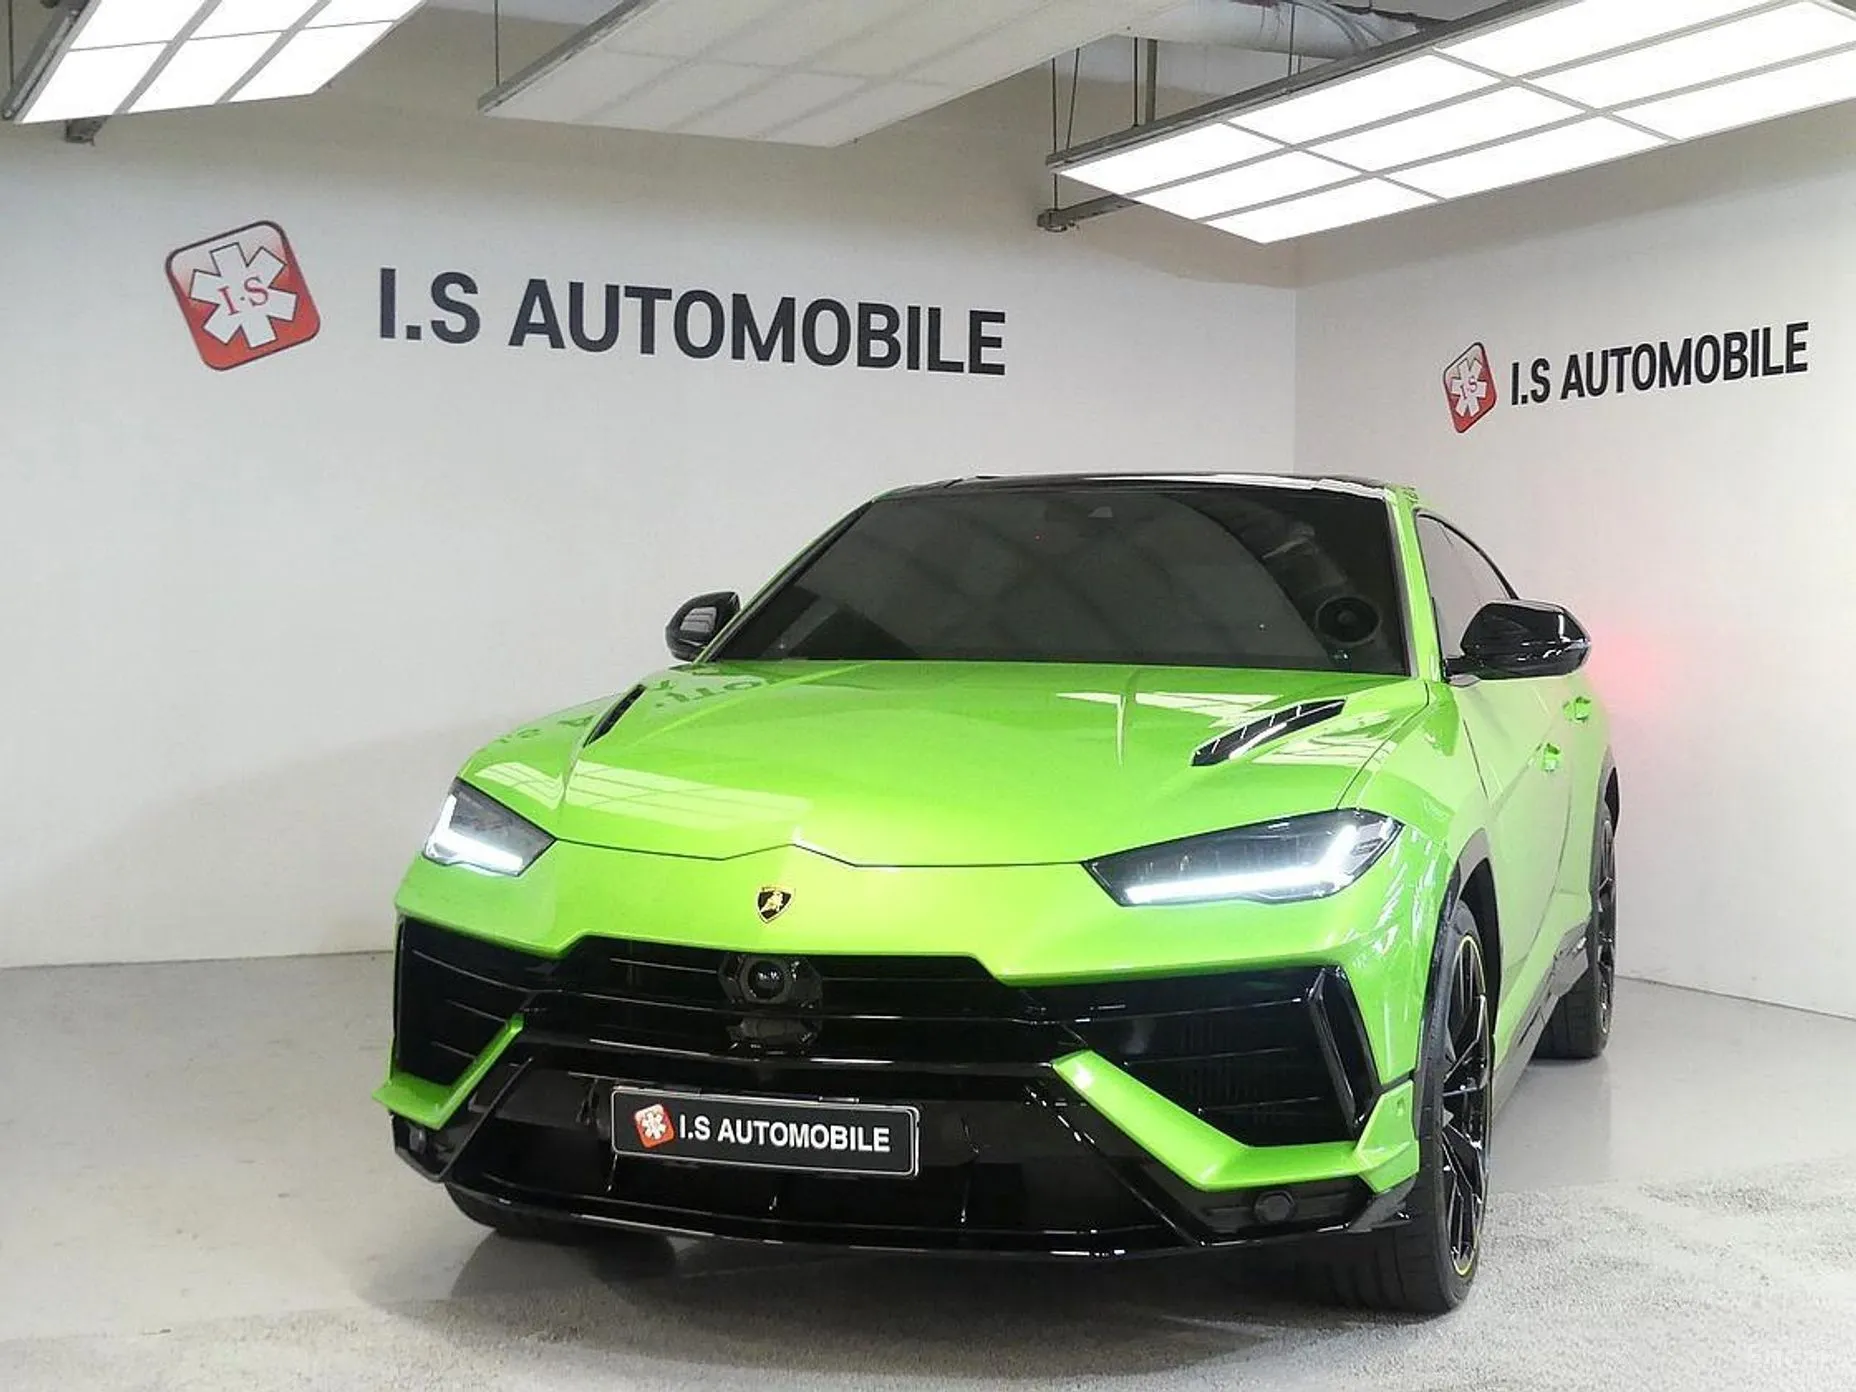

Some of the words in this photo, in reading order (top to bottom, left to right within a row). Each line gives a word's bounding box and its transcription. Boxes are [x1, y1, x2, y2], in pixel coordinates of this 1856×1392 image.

[379, 267, 481, 344] I.S
[508, 278, 1006, 376] AUTOMOBILE
[1511, 357, 1551, 406] I.S
[1559, 321, 1809, 401] AUTOMOBILE
[679, 1114, 711, 1141] I.S
[717, 1118, 891, 1153] AUTOMOBILE
